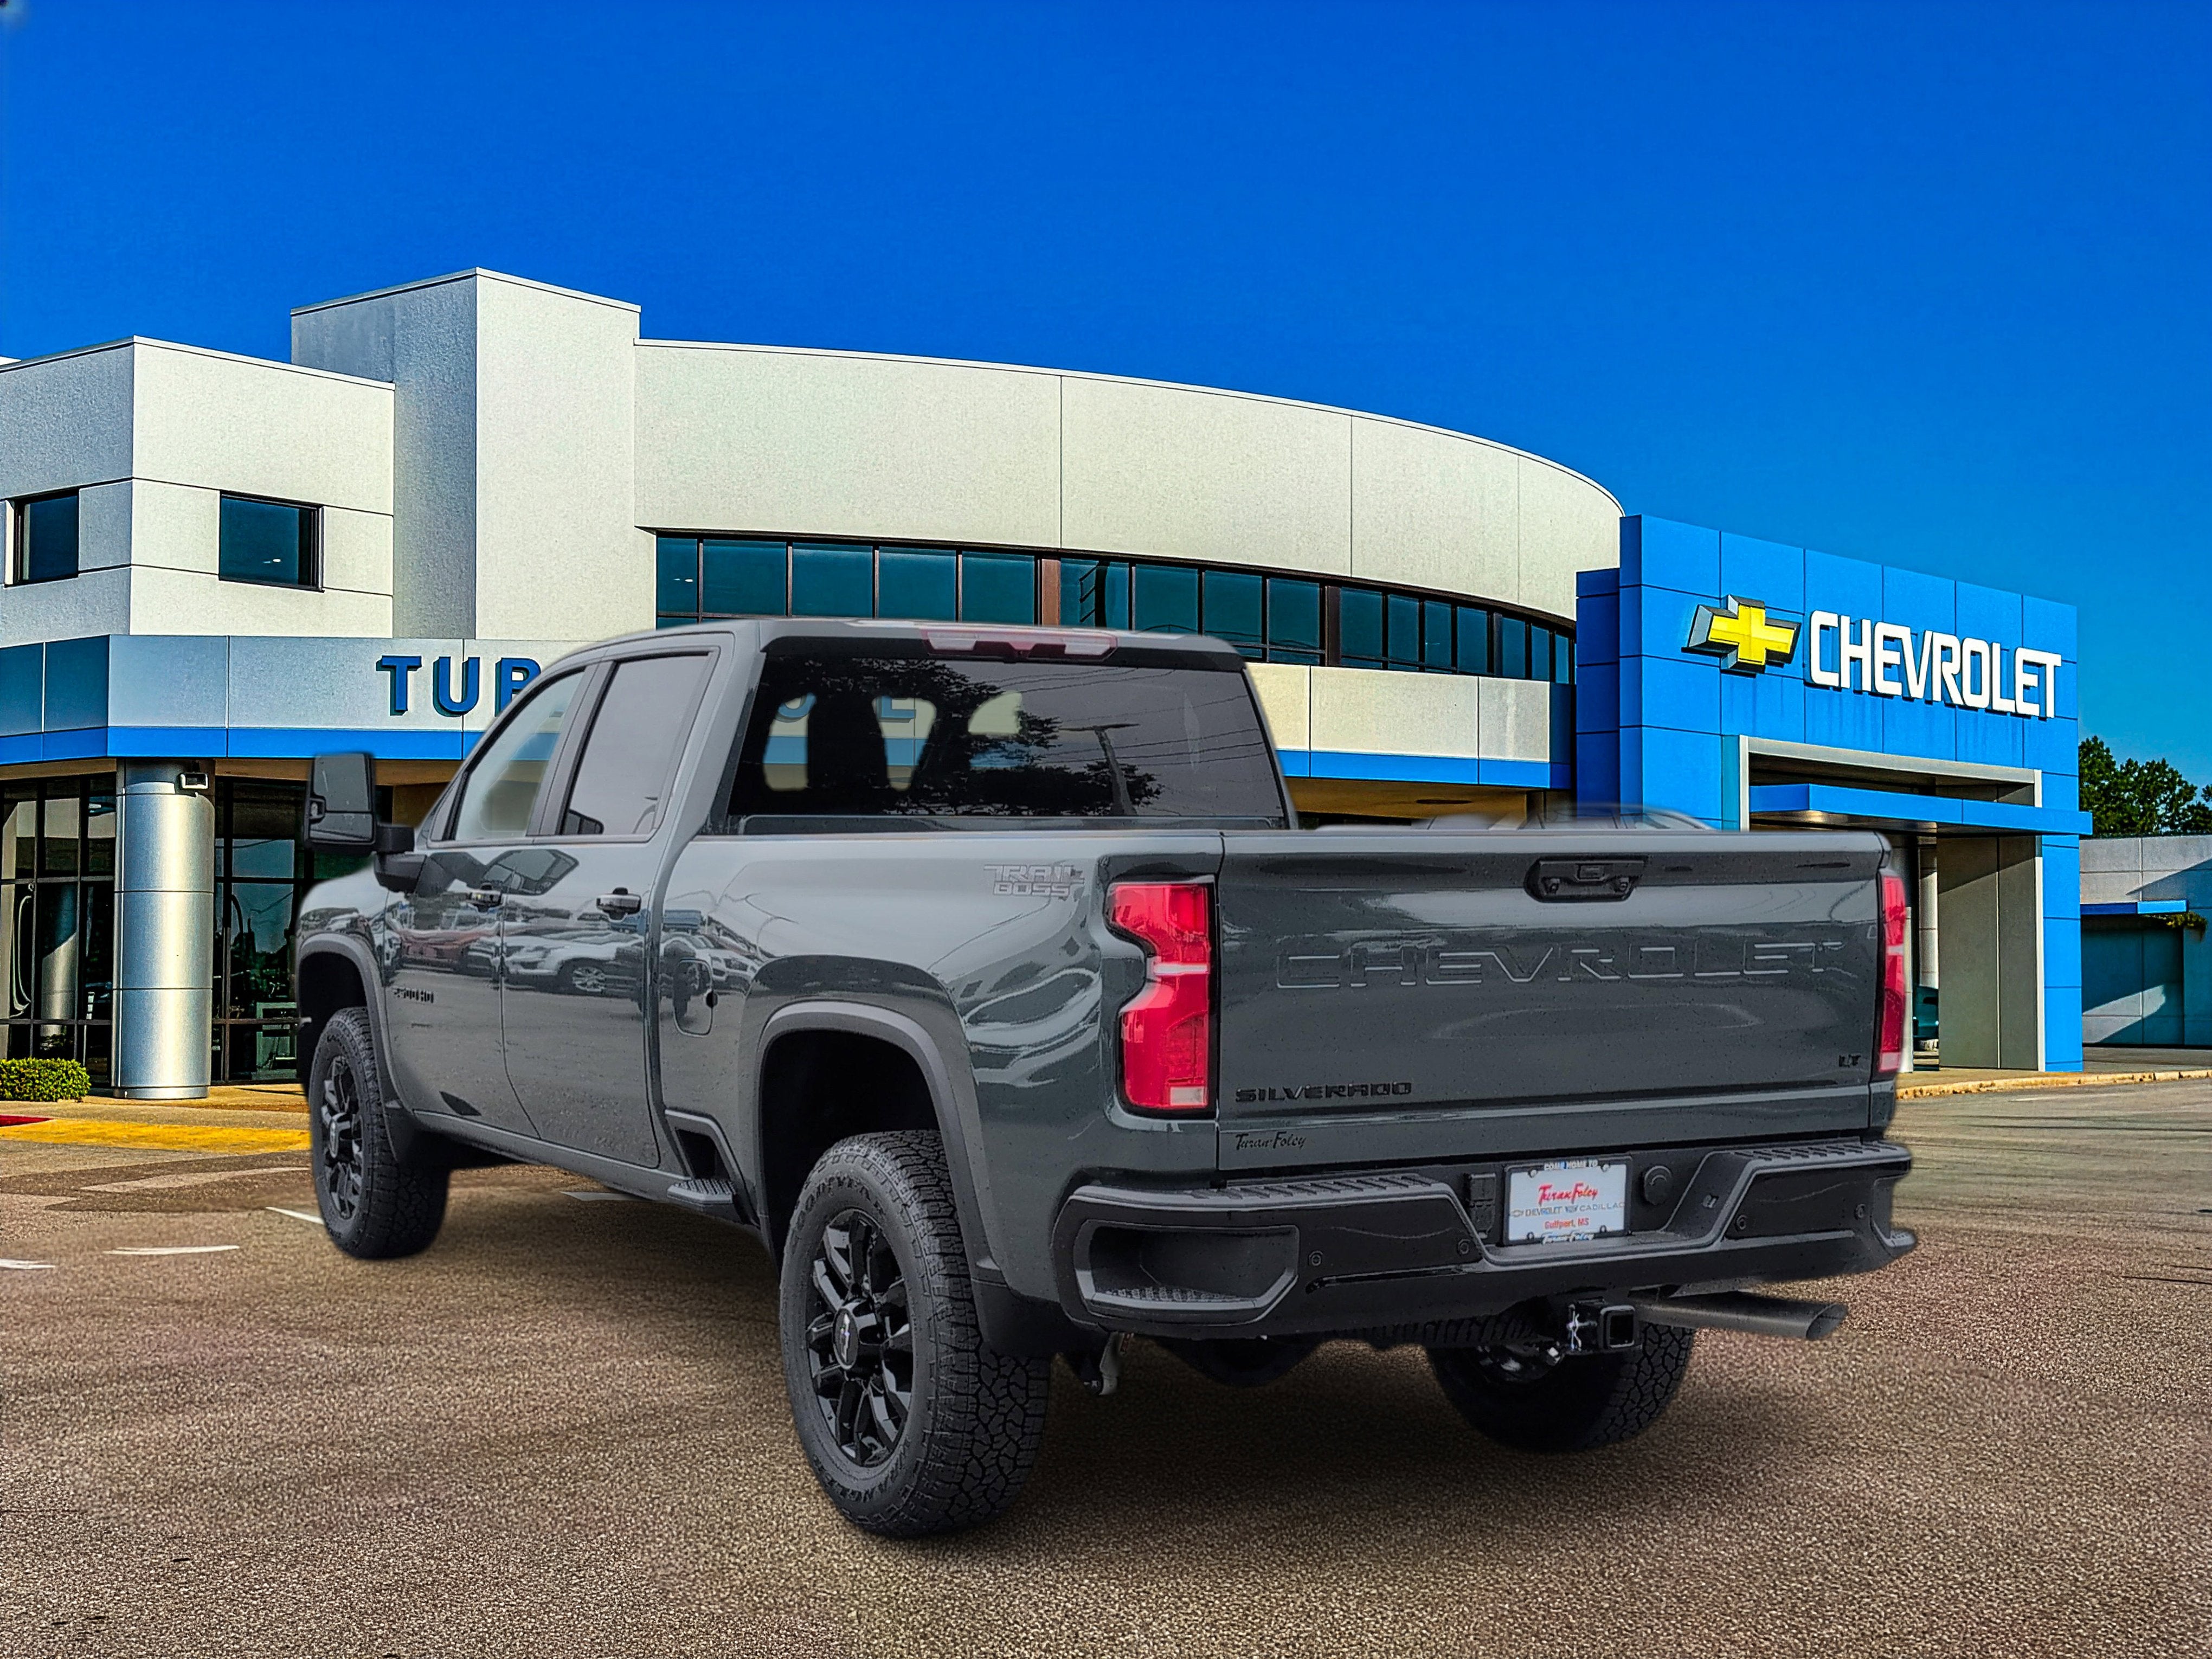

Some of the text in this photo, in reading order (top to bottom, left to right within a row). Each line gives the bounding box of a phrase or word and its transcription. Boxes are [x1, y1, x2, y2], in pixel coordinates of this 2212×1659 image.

[1810, 610, 2062, 718] CHEVROLET
[983, 864, 1085, 884] TRAIL
[993, 881, 1071, 896] BOSS
[1276, 938, 1843, 988] CHEVROLET
[1838, 1054, 1862, 1068] LT
[1235, 1082, 1412, 1103] SILVERADO
[1579, 1201, 1625, 1212] CADILLAC
